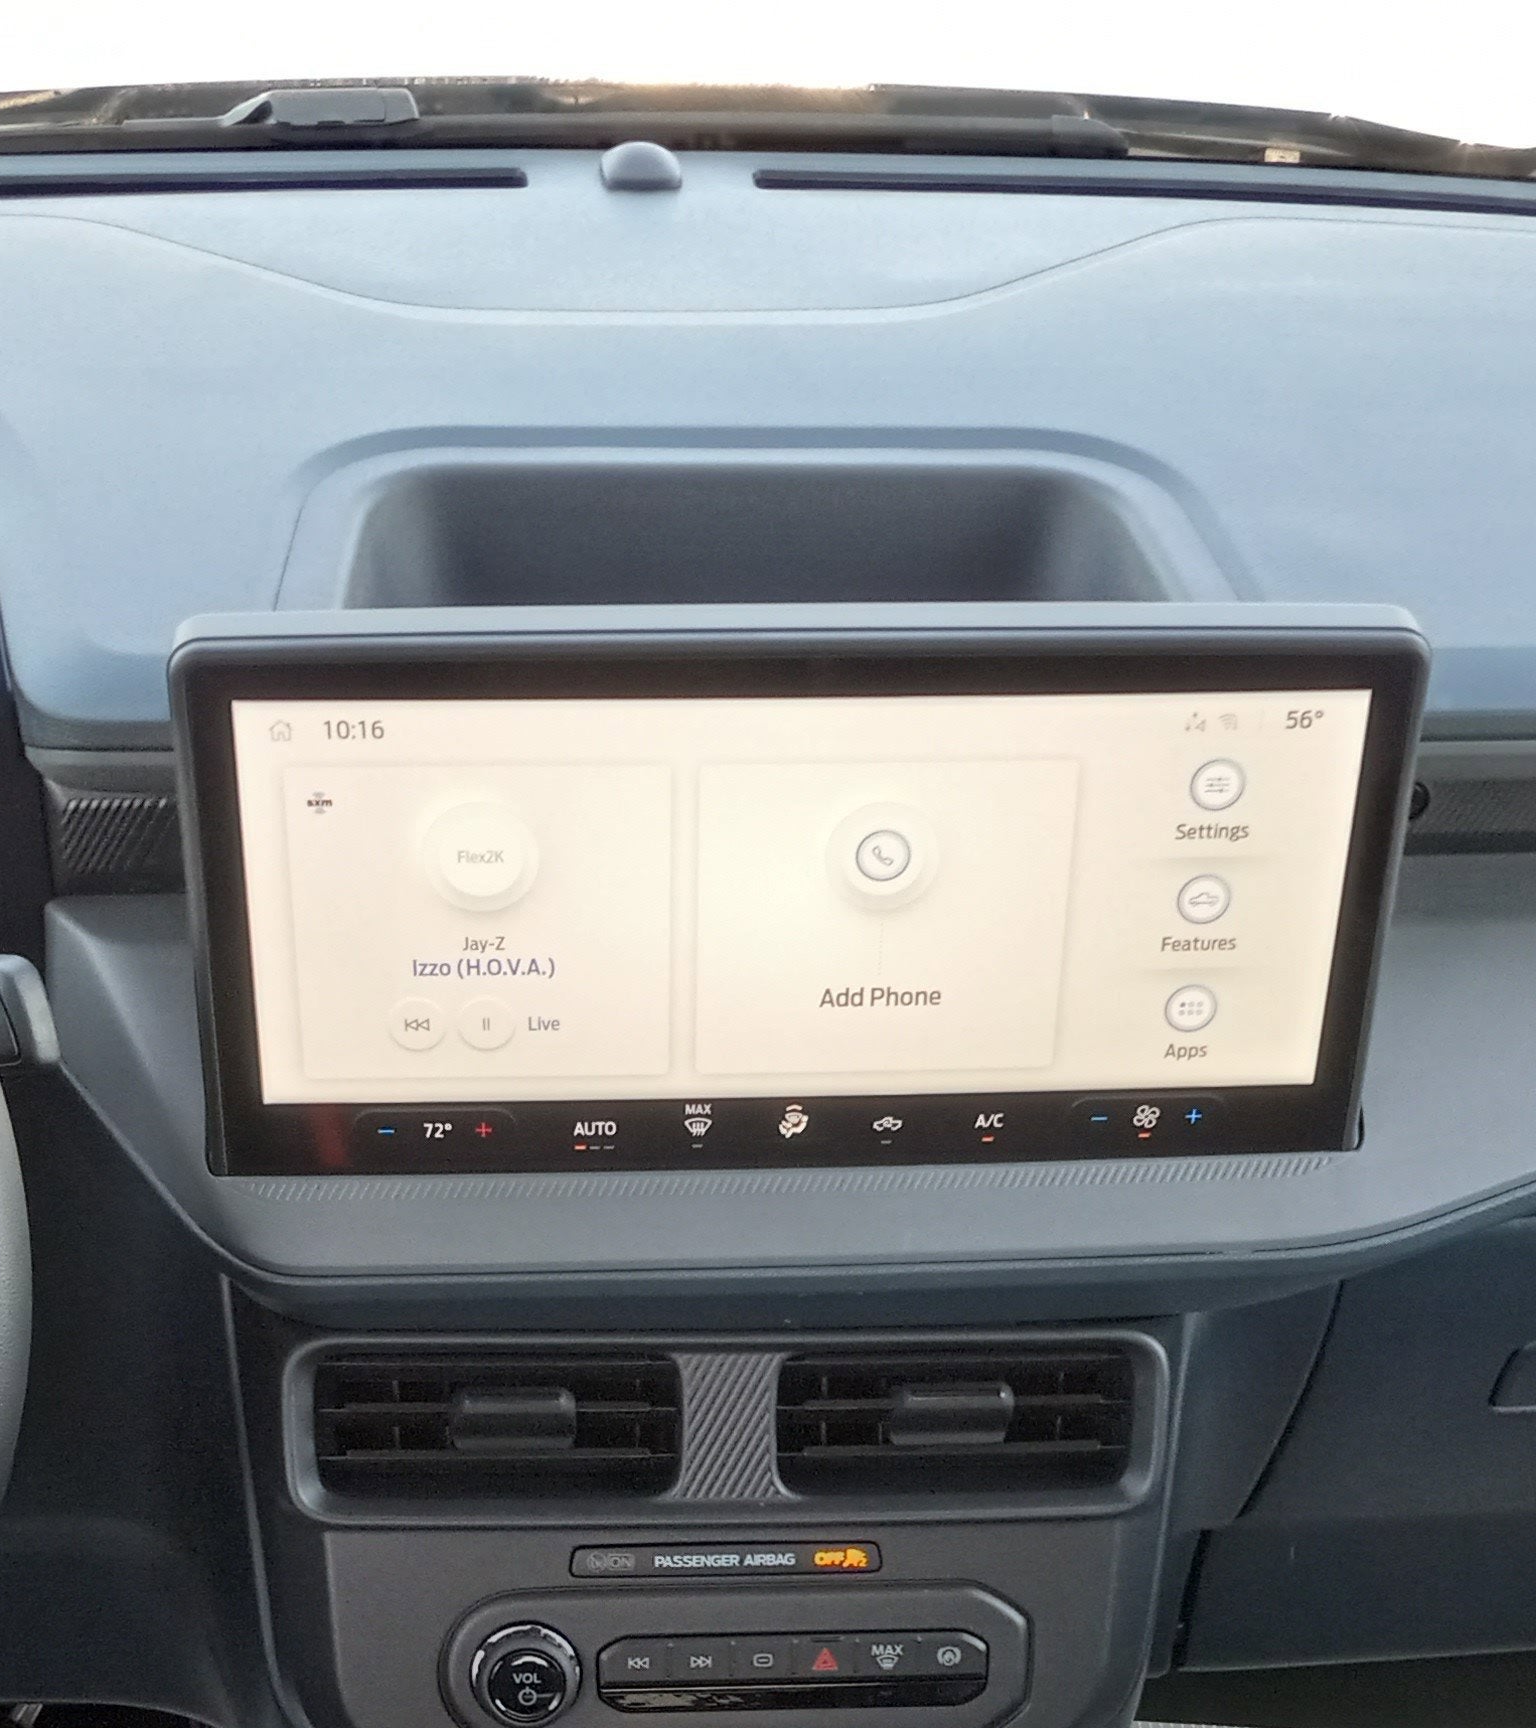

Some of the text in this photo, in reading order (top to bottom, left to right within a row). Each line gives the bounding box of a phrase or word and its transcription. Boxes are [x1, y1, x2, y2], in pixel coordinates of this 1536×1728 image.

[323, 720, 386, 740] 10:16
[1175, 822, 1250, 842] Settings
[463, 936, 506, 953] Jay-Z
[1160, 934, 1237, 952] Features
[412, 957, 556, 979] Izzo (H.O.V.A.)
[819, 986, 942, 1008] Add Phone
[528, 1016, 561, 1032] Live
[1164, 1043, 1208, 1062] Apps
[684, 1103, 712, 1116] MAX
[573, 1121, 617, 1138] AUTO
[974, 1113, 1004, 1130] A/C
[654, 1554, 740, 1568] PASSENGER
[742, 1553, 796, 1567] AIRBAG
[871, 1645, 903, 1657] MAX
[513, 1673, 541, 1685] VOL
